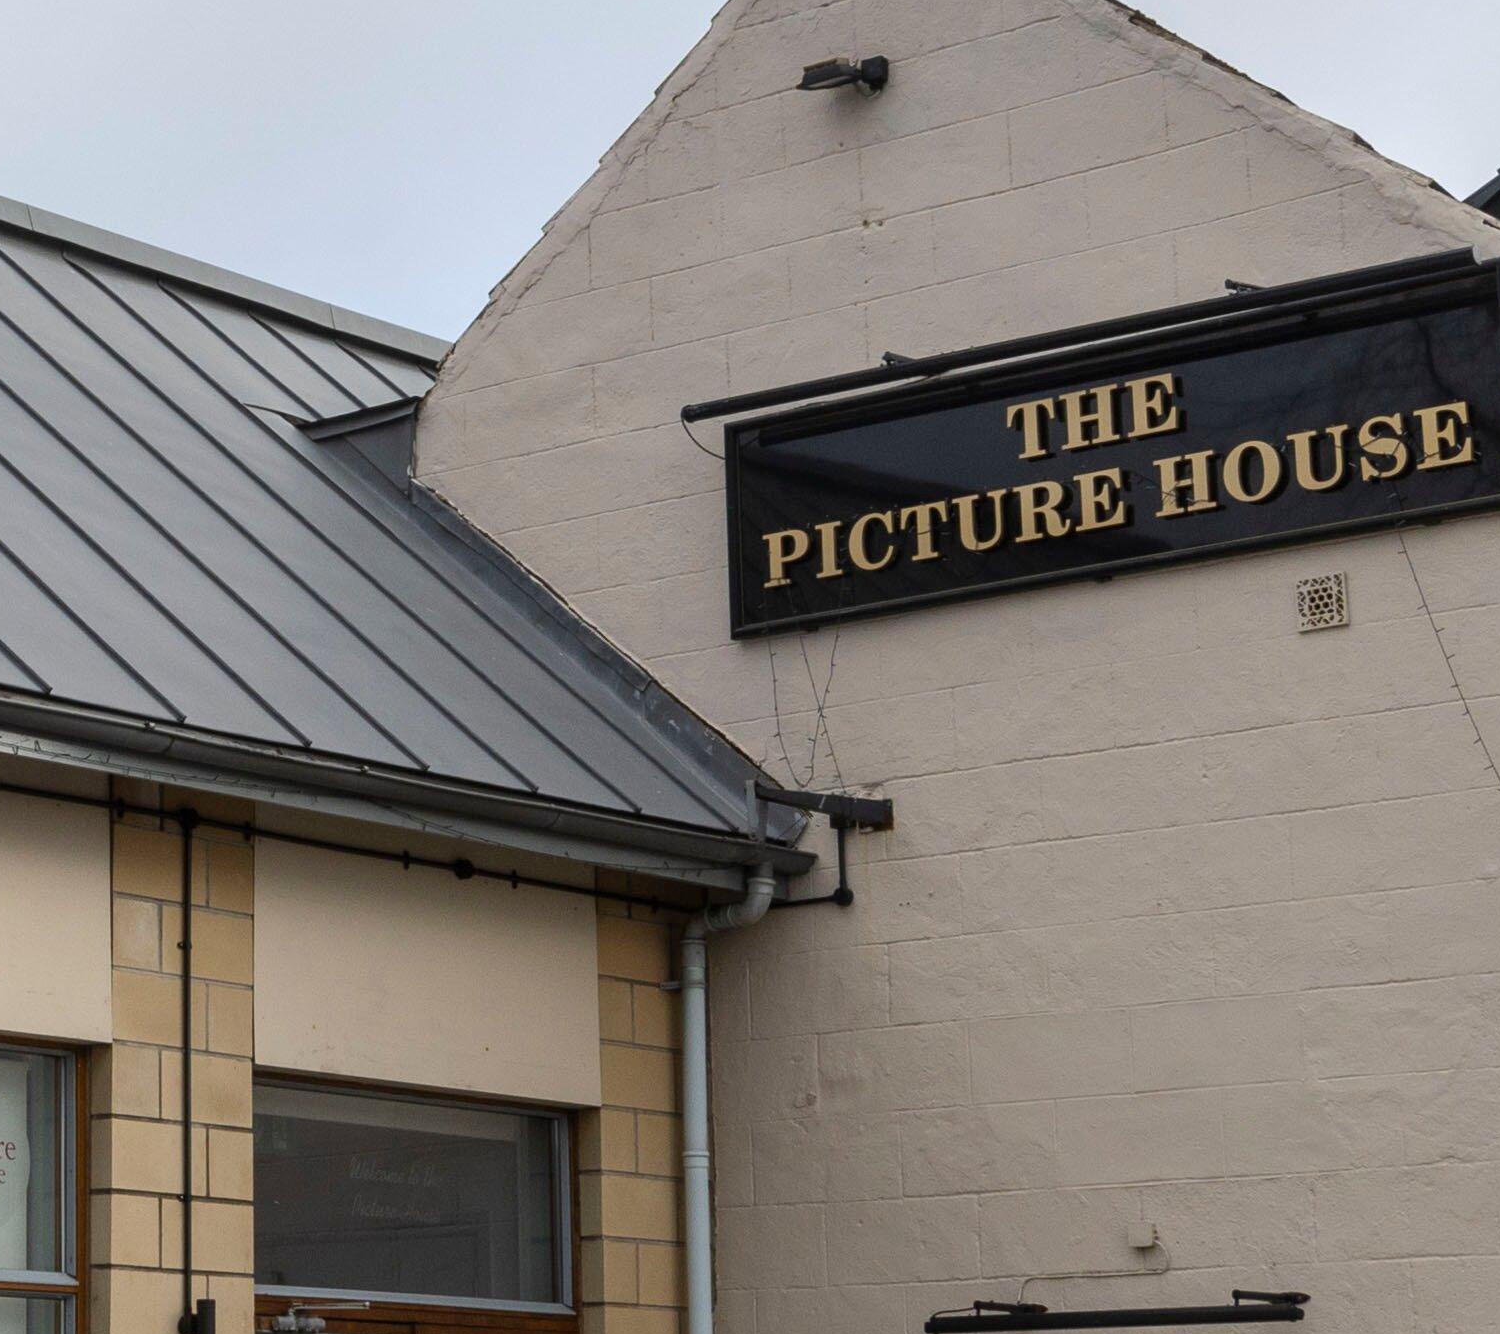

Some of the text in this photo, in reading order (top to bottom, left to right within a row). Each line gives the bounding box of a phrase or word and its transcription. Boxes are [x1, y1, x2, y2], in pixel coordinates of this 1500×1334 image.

[1006, 372, 1180, 460] THE
[762, 401, 1475, 588] PICTURE HOUSE
